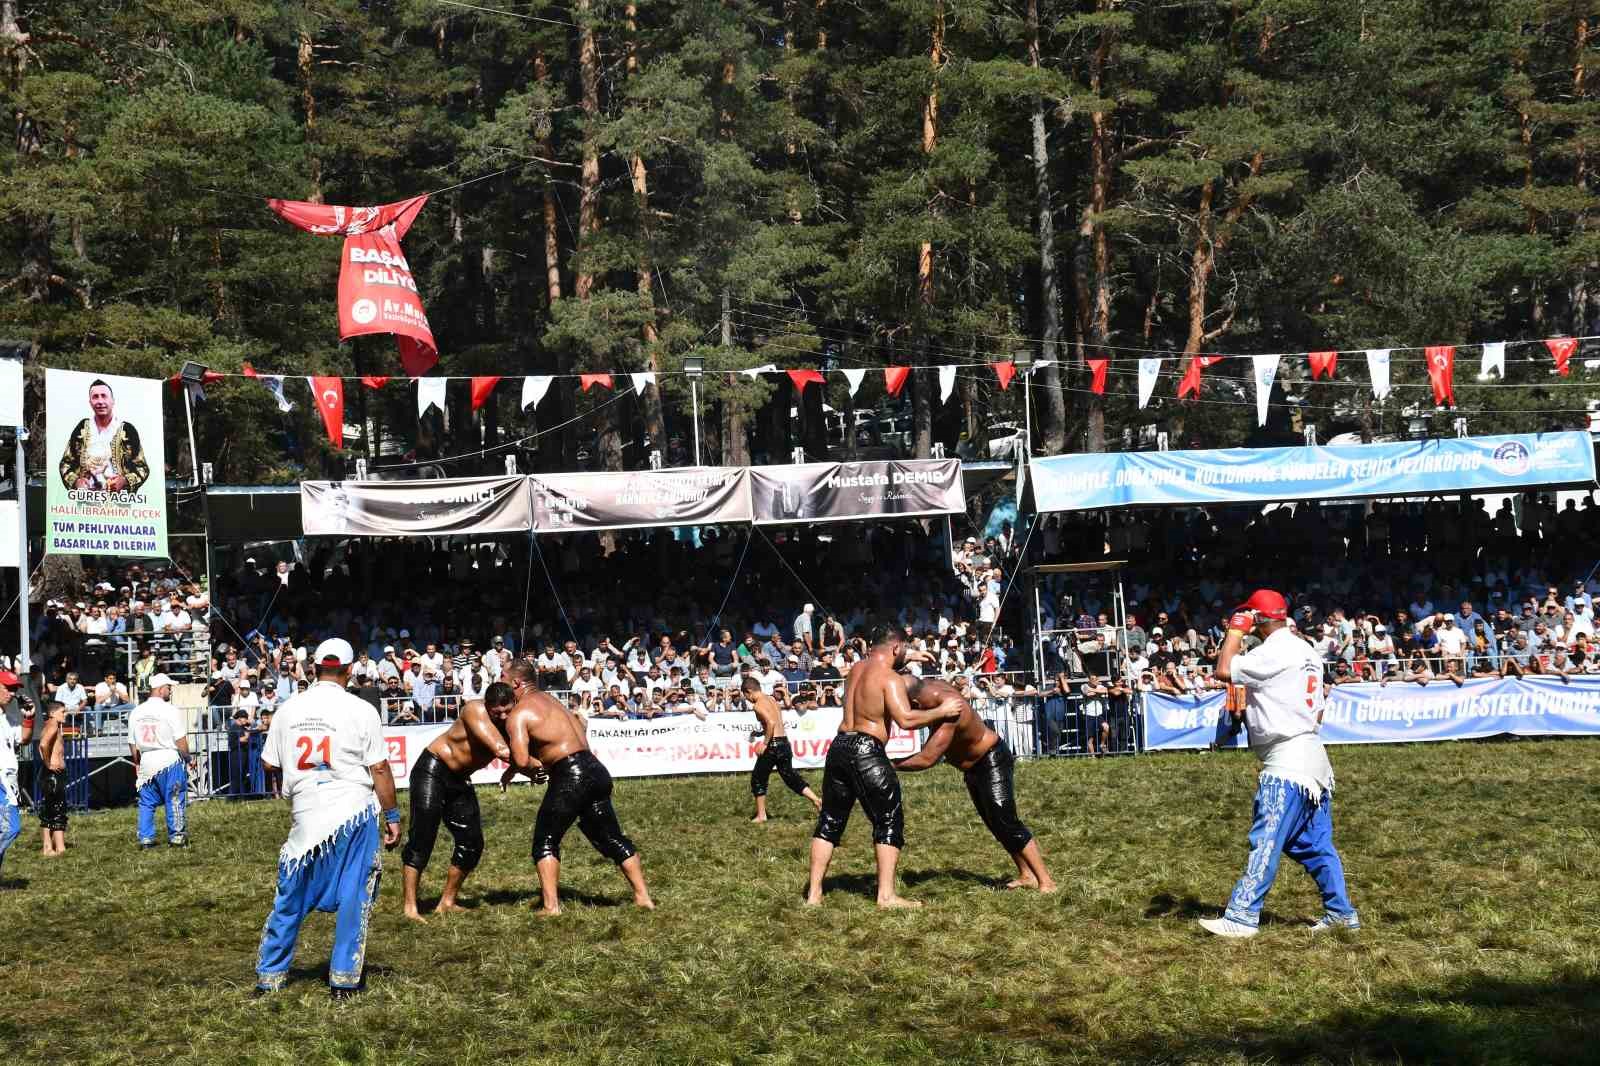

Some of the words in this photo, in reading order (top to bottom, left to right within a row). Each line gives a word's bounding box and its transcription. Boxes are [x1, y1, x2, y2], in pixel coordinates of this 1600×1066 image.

[828, 473, 888, 489] Mustafa
[68, 488, 107, 504] GÜREŞ
[110, 490, 147, 504] AĞASI
[591, 727, 648, 738] BAKANLIĞI
[296, 735, 331, 770] 21
